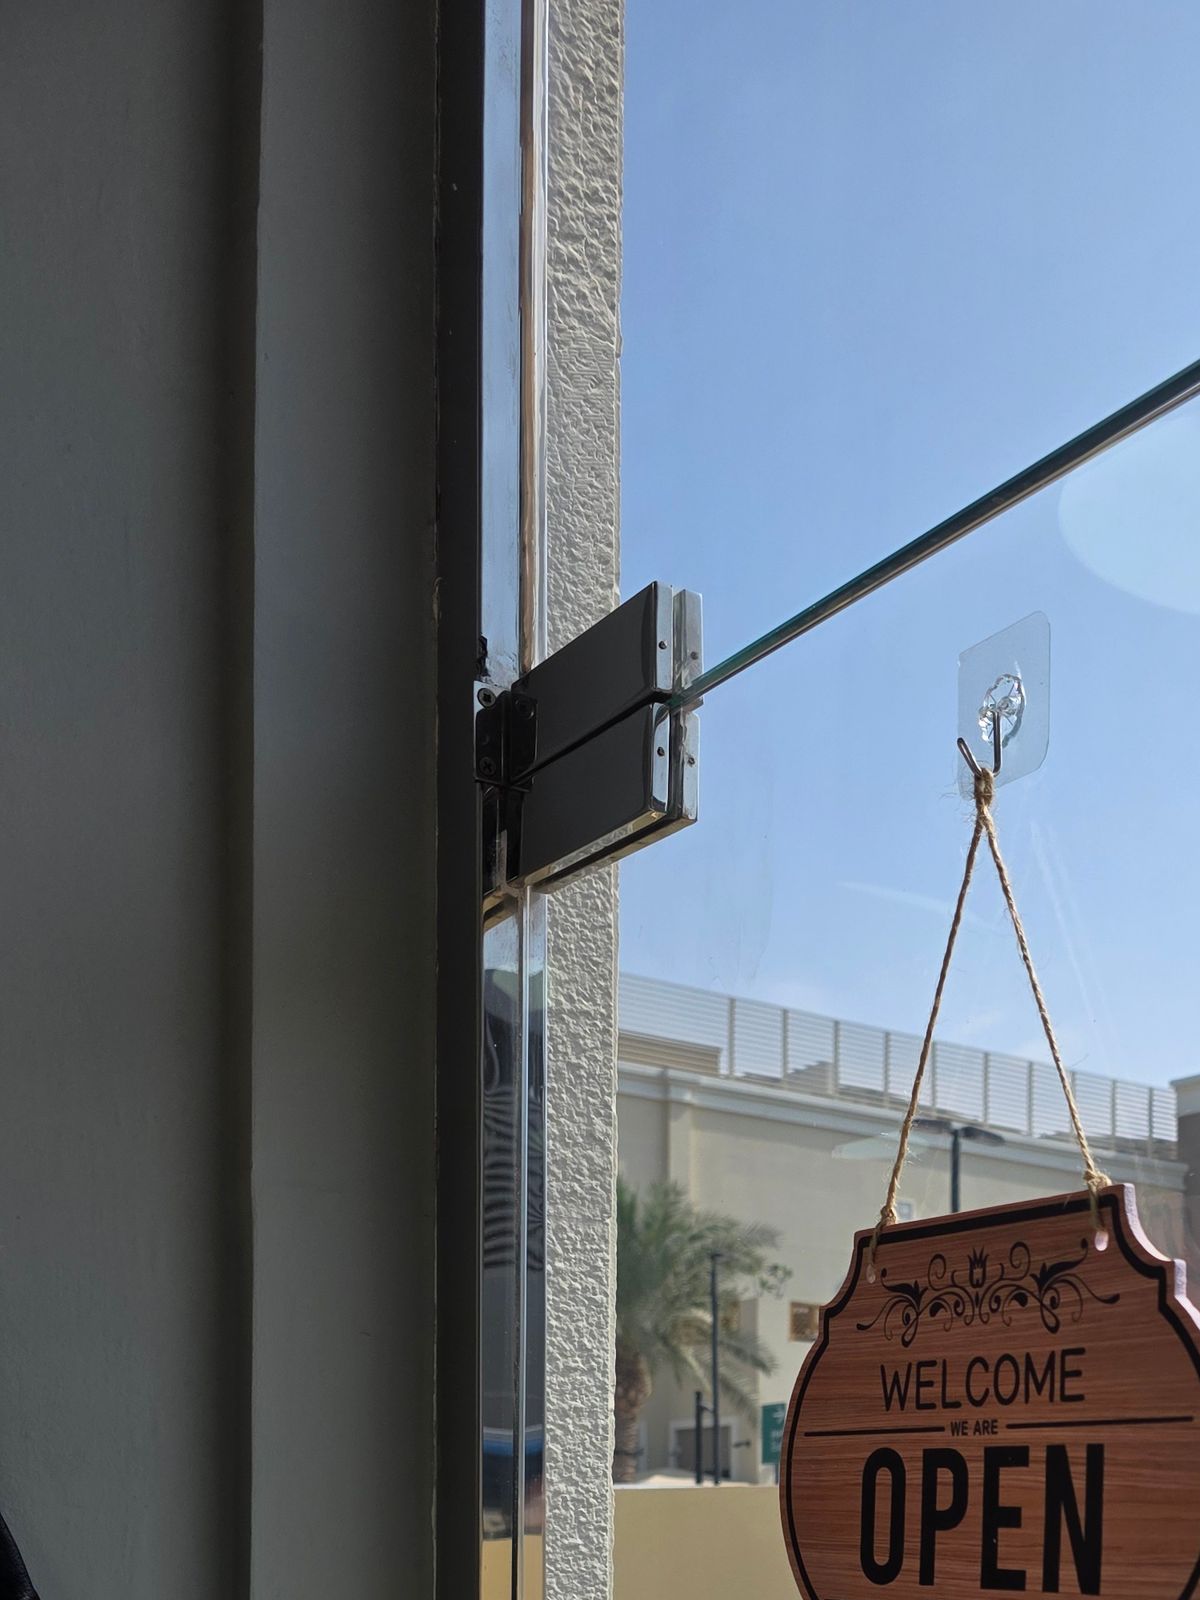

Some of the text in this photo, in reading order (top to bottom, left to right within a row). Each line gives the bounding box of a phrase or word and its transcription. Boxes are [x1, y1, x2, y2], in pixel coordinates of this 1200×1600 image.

[879, 1347, 1087, 1412] WELCOME
[950, 1419, 999, 1437] WE ARE
[859, 1443, 1105, 1596] OPEN
